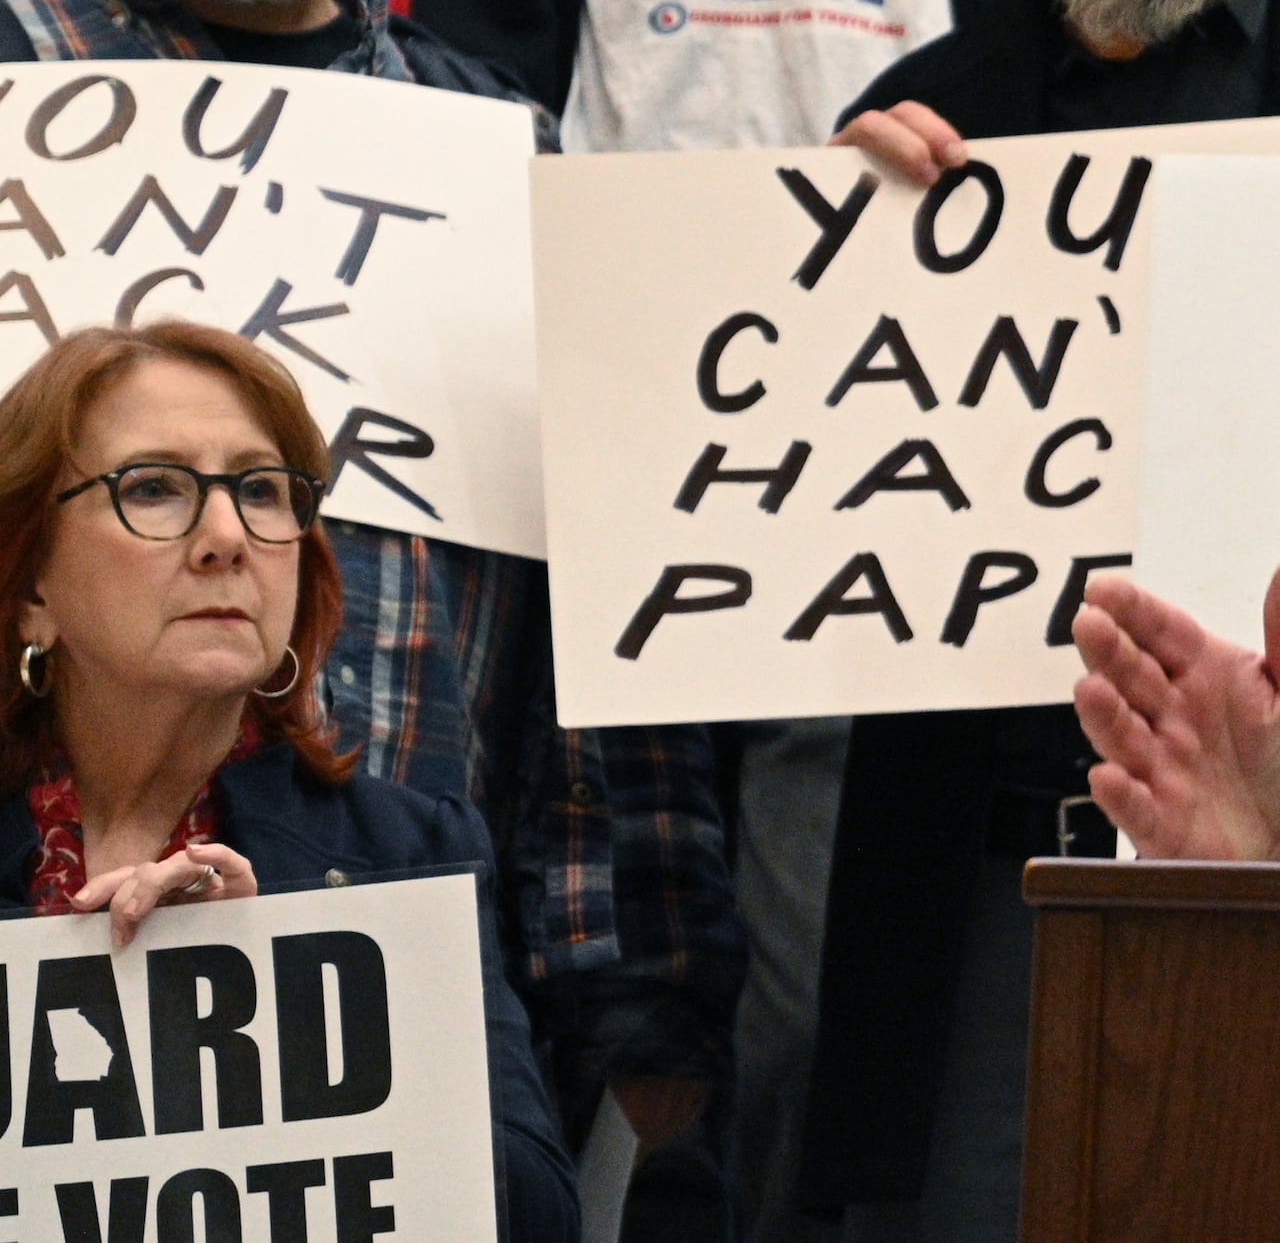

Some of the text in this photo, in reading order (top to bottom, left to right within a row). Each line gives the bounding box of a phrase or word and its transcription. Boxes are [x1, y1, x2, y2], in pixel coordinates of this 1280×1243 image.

[0, 74, 289, 175] OU
[776, 153, 1153, 291] YOU
[696, 294, 1122, 415] CAN'
[673, 417, 1113, 514] HAC
